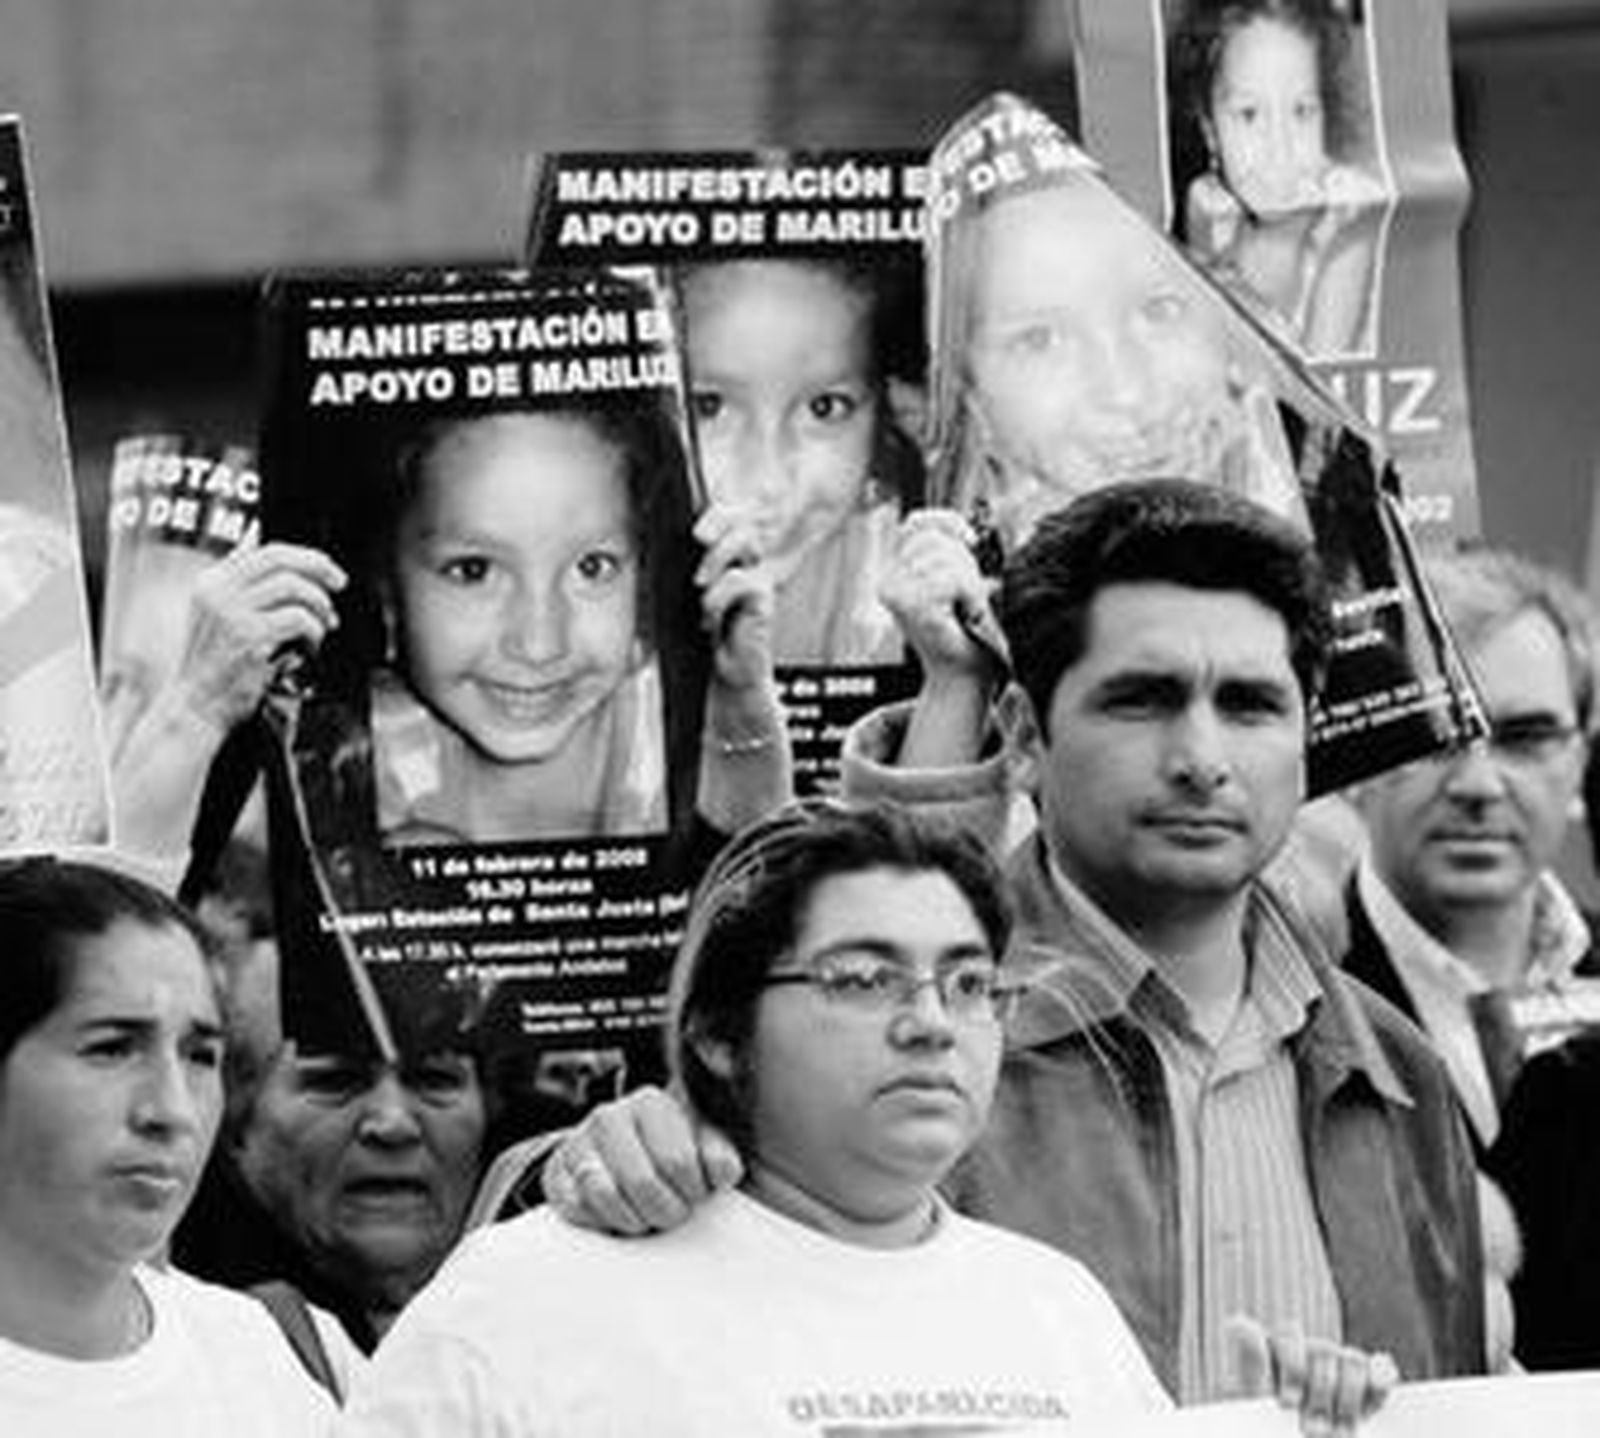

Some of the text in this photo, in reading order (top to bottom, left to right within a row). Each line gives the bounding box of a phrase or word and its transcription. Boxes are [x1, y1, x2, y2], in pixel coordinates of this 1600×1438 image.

[557, 162, 891, 202] MANIFESTACIÓN
[559, 212, 700, 246] APOYO
[711, 210, 766, 244] DE
[307, 307, 628, 360] MANIFESTACIÓN
[309, 367, 455, 405] APOYO
[467, 363, 522, 398] DE
[442, 858, 470, 877] de
[561, 849, 589, 870] de
